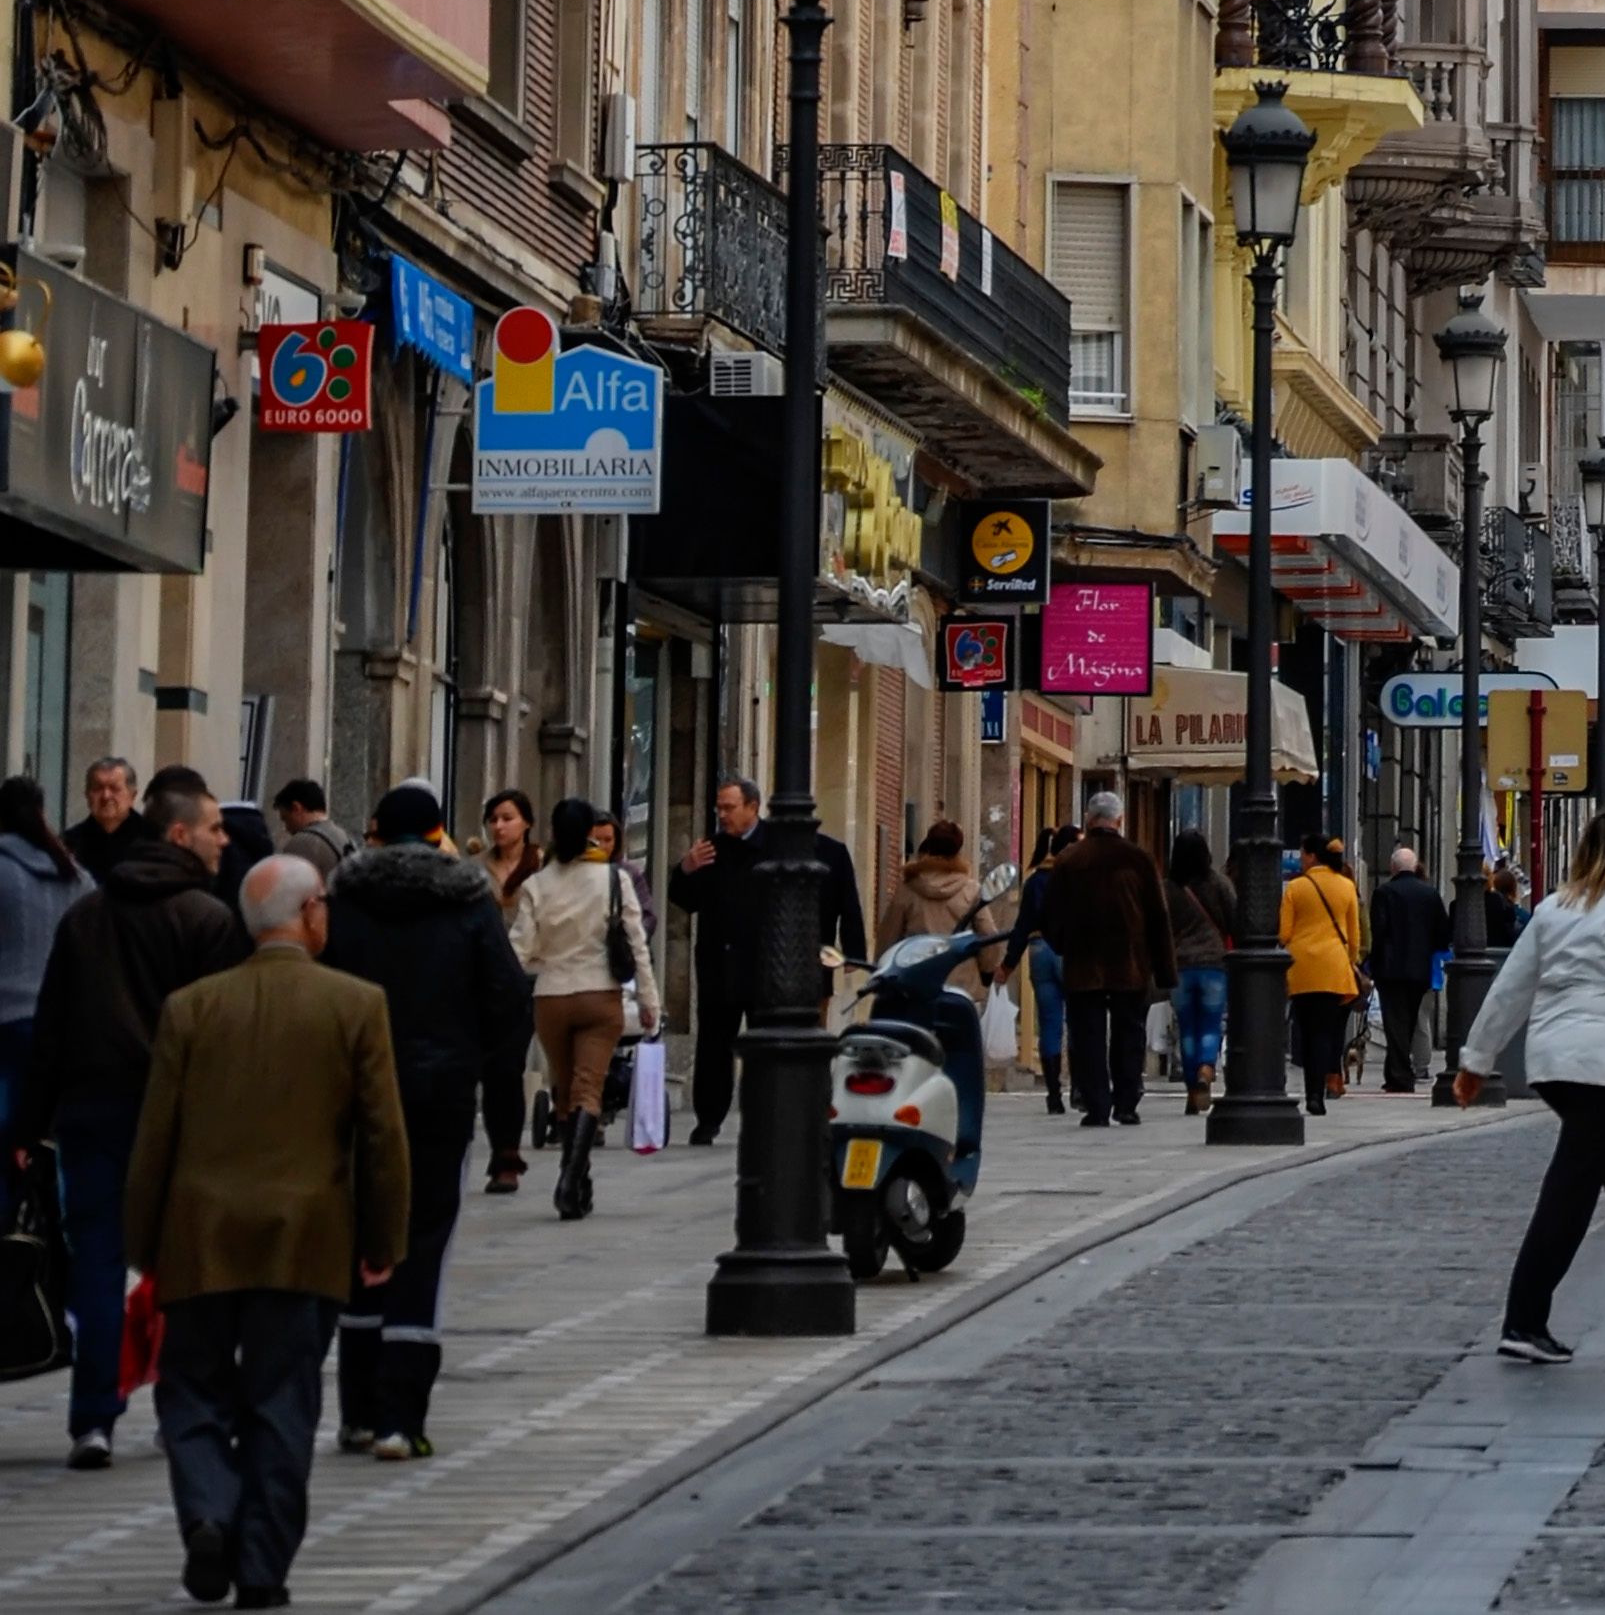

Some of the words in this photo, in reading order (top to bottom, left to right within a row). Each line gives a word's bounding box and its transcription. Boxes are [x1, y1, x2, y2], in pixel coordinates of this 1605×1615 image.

[559, 369, 649, 412] Alfa
[264, 409, 311, 425] EURO
[314, 409, 363, 425] 6000
[477, 457, 653, 478] INMOBILIARIA
[986, 577, 1038, 592] ServiRed
[1075, 589, 1121, 612] Flor
[1086, 629, 1107, 644] de
[1135, 714, 1163, 746] LA
